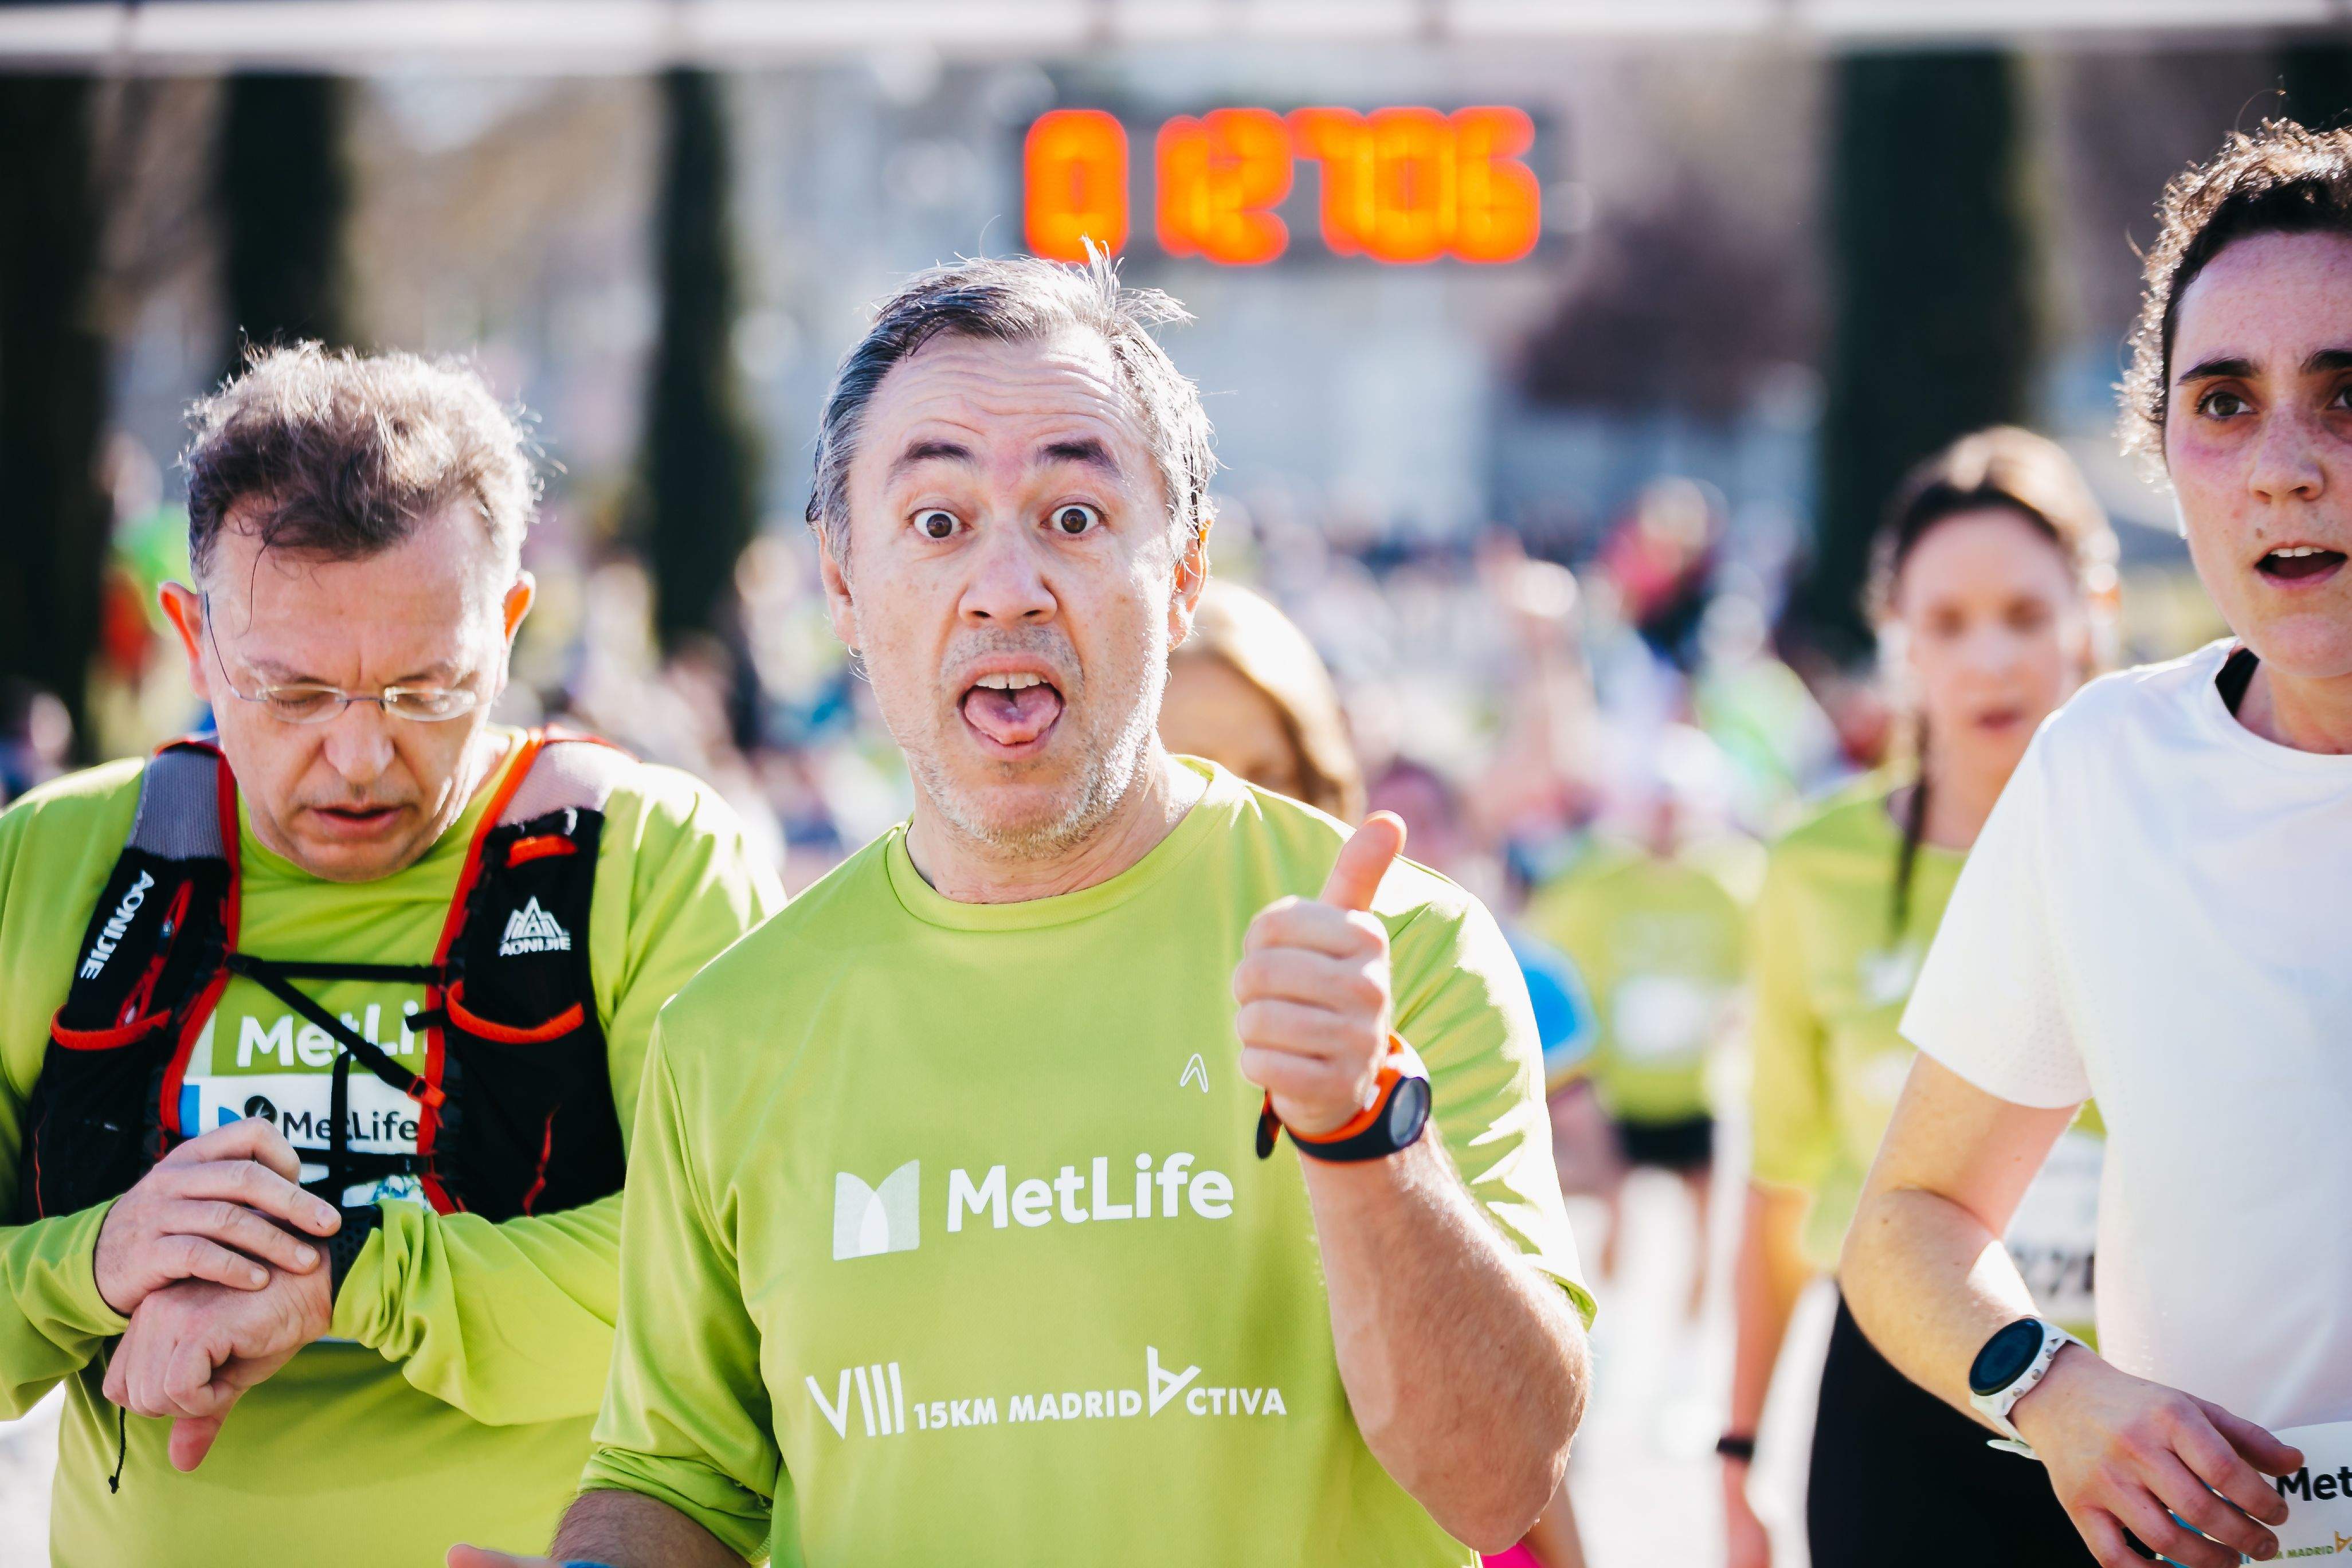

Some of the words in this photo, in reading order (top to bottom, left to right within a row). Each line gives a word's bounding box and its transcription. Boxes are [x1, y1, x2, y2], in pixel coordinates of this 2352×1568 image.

[80, 869, 155, 979] AONIJIE
[237, 1000, 428, 1068] MetLi
[283, 1111, 420, 1142] MeLife
[947, 1152, 1234, 1232] MetLife
[806, 1362, 905, 1439] VIII
[914, 1397, 997, 1429] 15KM
[1009, 1389, 1142, 1423] MADRID
